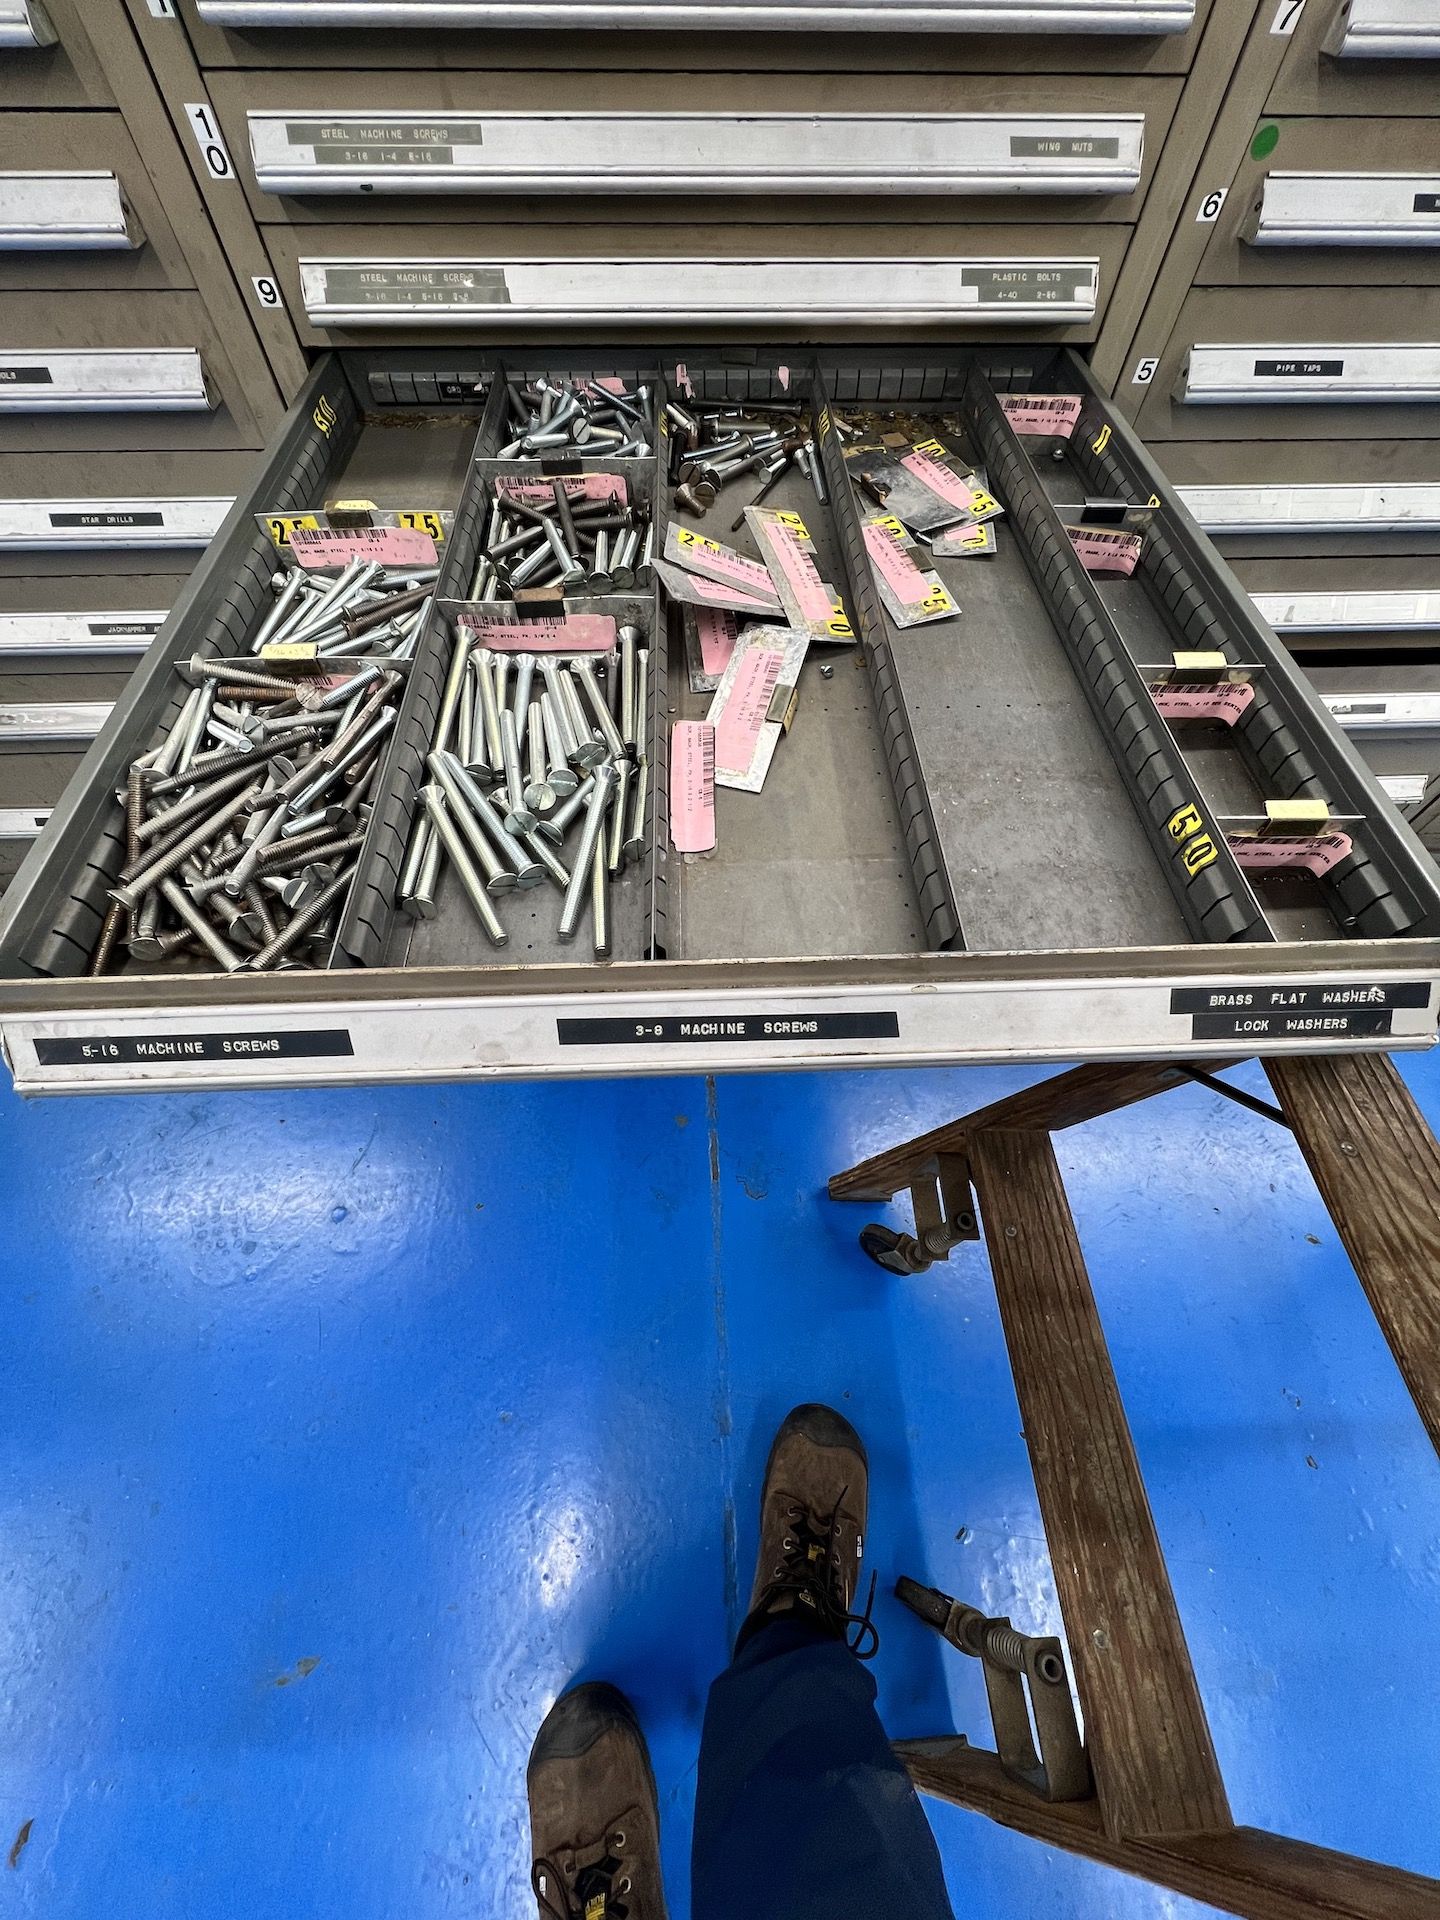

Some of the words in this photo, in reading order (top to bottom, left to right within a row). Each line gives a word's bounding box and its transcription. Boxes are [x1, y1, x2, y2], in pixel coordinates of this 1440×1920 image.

[320, 128, 350, 140] STEEL
[359, 128, 403, 140] MACHINE
[412, 128, 449, 141] SCREWS
[1036, 141, 1061, 152] WING
[1071, 141, 1094, 153] NUTS
[1202, 190, 1223, 218] 6
[359, 272, 387, 283] STEEL
[396, 273, 434, 283] MACHINE
[991, 272, 1028, 282] PLASTIC
[1035, 272, 1062, 282] BOLTS
[256, 278, 278, 305] 9
[997, 290, 1018, 300] 4-40
[1136, 360, 1156, 382] 5
[1275, 364, 1296, 373] PIPE
[81, 516, 100, 524] STAR
[106, 515, 134, 524] DRILLS
[1209, 994, 1254, 1007] BRASS
[1270, 992, 1307, 1005] FLAT
[1321, 988, 1387, 1004] WASHERS
[634, 1024, 664, 1037] 3-8
[680, 1022, 746, 1036] MACHINE
[762, 1020, 819, 1034] SCREWS
[1234, 1019, 1270, 1032] LOCK
[1286, 1018, 1349, 1031] WASHERS
[81, 1043, 120, 1058] 5-16
[136, 1041, 205, 1056] MACHINE
[222, 1039, 281, 1053] SCREWS
